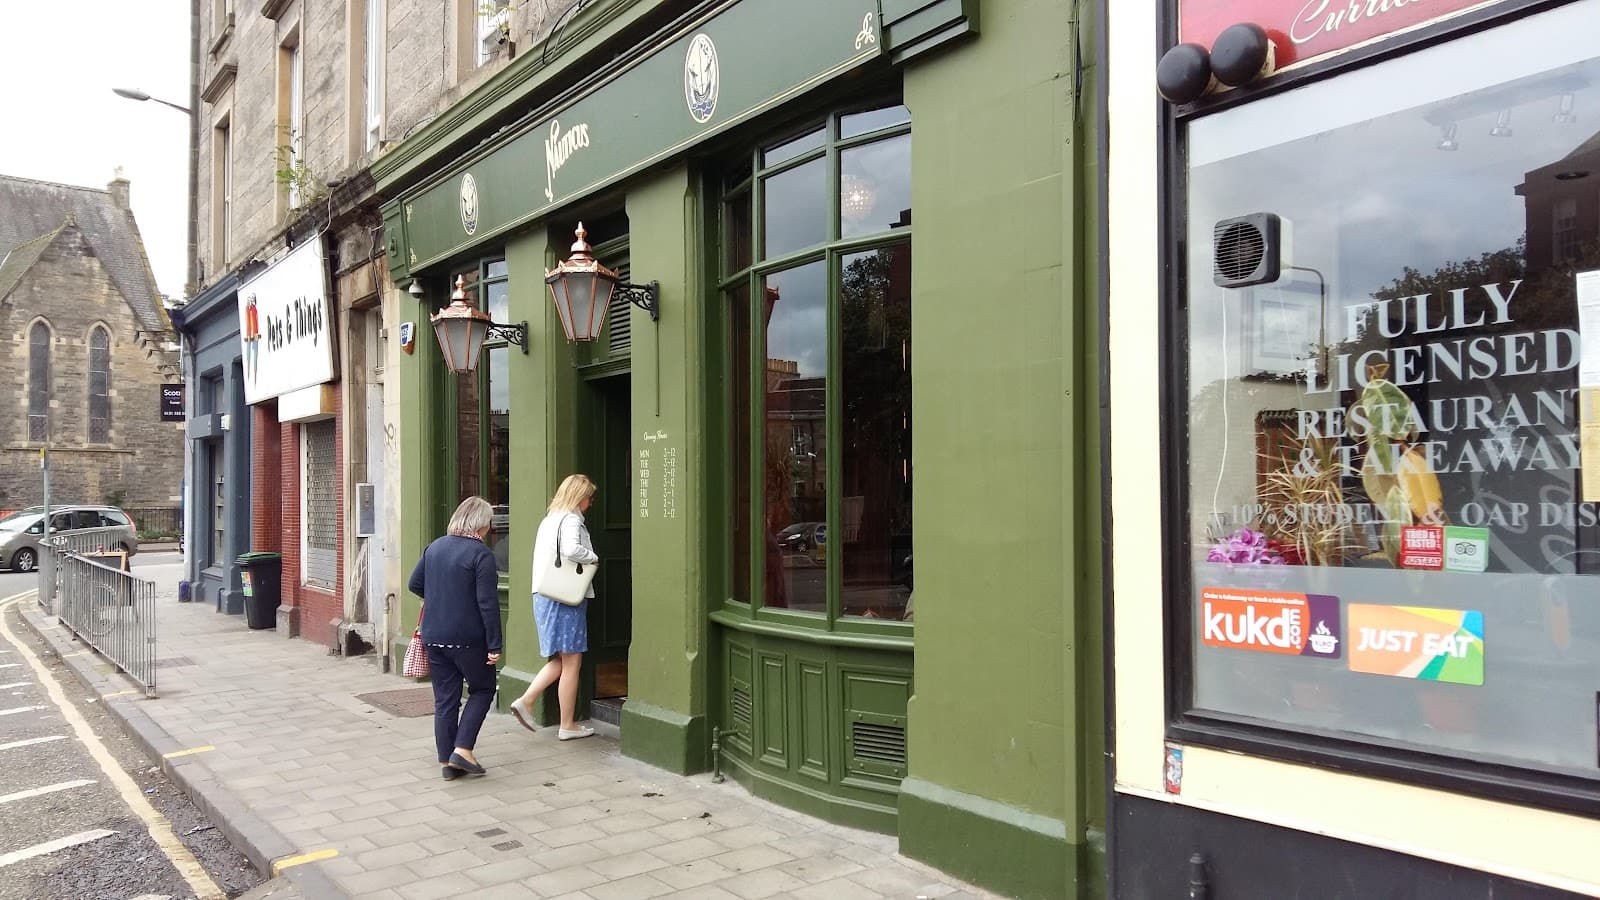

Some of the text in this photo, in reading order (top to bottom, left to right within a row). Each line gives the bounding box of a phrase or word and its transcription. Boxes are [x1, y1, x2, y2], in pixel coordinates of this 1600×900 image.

[267, 295, 322, 352] Pets & Things
[1344, 279, 1523, 343] FULLY
[1304, 328, 1581, 395] LICENSED
[1293, 434, 1583, 478] & TAKEAWAY
[1230, 502, 1276, 525] 10%
[1460, 502, 1530, 527] OAP
[1538, 502, 1600, 527] DIS
[1204, 602, 1301, 649] kukd .com
[1356, 627, 1474, 658] JUST EAT
